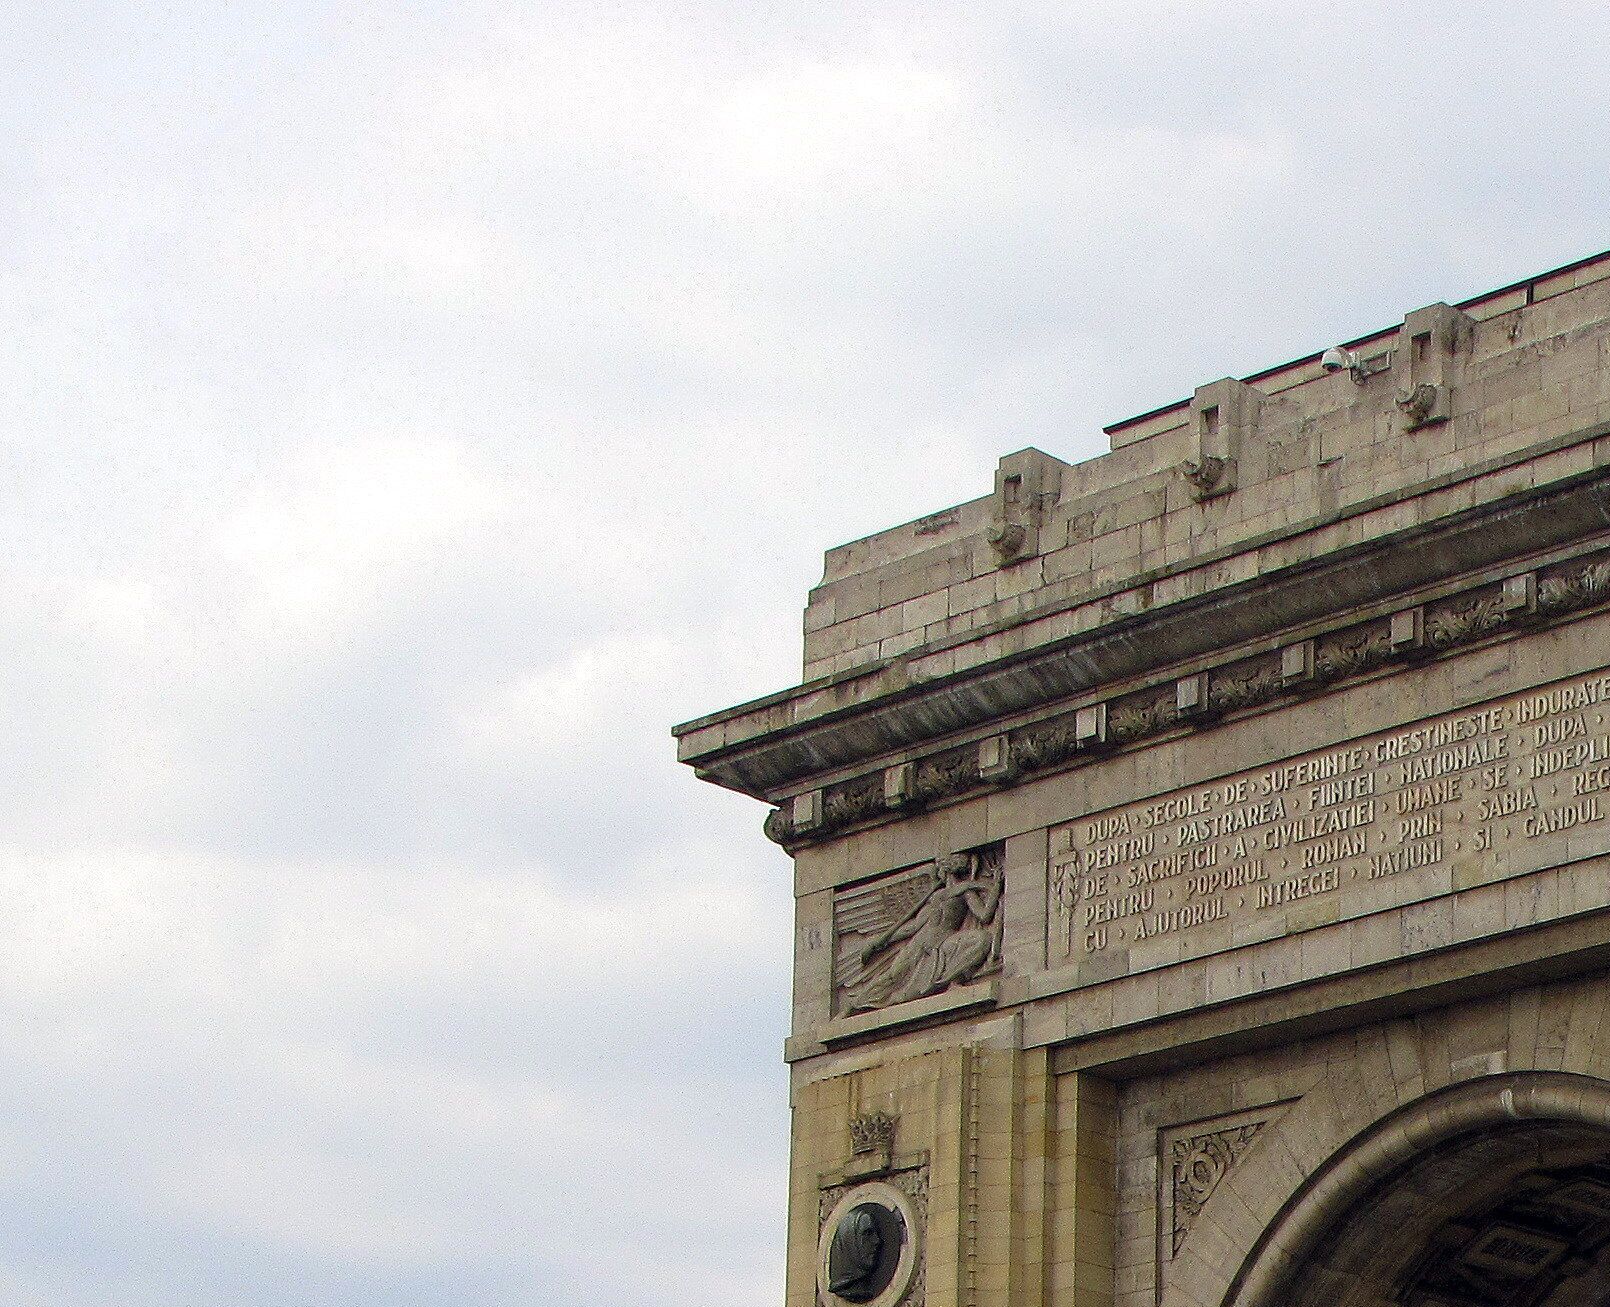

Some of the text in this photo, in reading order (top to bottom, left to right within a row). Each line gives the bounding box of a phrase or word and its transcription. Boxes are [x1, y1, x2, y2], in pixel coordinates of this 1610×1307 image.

[1085, 817, 1131, 845] DUPA
[1144, 793, 1212, 829] SECOLE
[1223, 778, 1250, 805] DE
[1261, 744, 1363, 795] SUFERINTE
[1375, 707, 1504, 763] CRESTINESTE
[1085, 833, 1155, 873] PENTRU
[1177, 797, 1286, 847] PASTRAREA
[1309, 772, 1375, 811] FIINTEI
[1400, 734, 1509, 785] NATIONALE
[1535, 713, 1588, 748] DUPA
[1085, 874, 1108, 900] DE
[1128, 842, 1218, 888] SACRIFICII
[1234, 836, 1247, 860] A
[1264, 800, 1375, 850] CIVILIZATIEI
[1396, 776, 1463, 815] UMANE
[1481, 763, 1509, 791] SE
[1085, 888, 1155, 927] PENTRU
[1186, 860, 1269, 900] POPORUL
[1302, 831, 1368, 869] ROMAN
[1399, 810, 1443, 844] PRIN
[1478, 785, 1539, 821] SABIA
[1085, 927, 1108, 954] CU
[1134, 896, 1228, 941] AJUTORUL
[1256, 867, 1340, 910] INTREGEI
[1369, 839, 1443, 880] NATIUNI
[1474, 826, 1493, 851] SI
[1524, 796, 1605, 838] GANDUL
